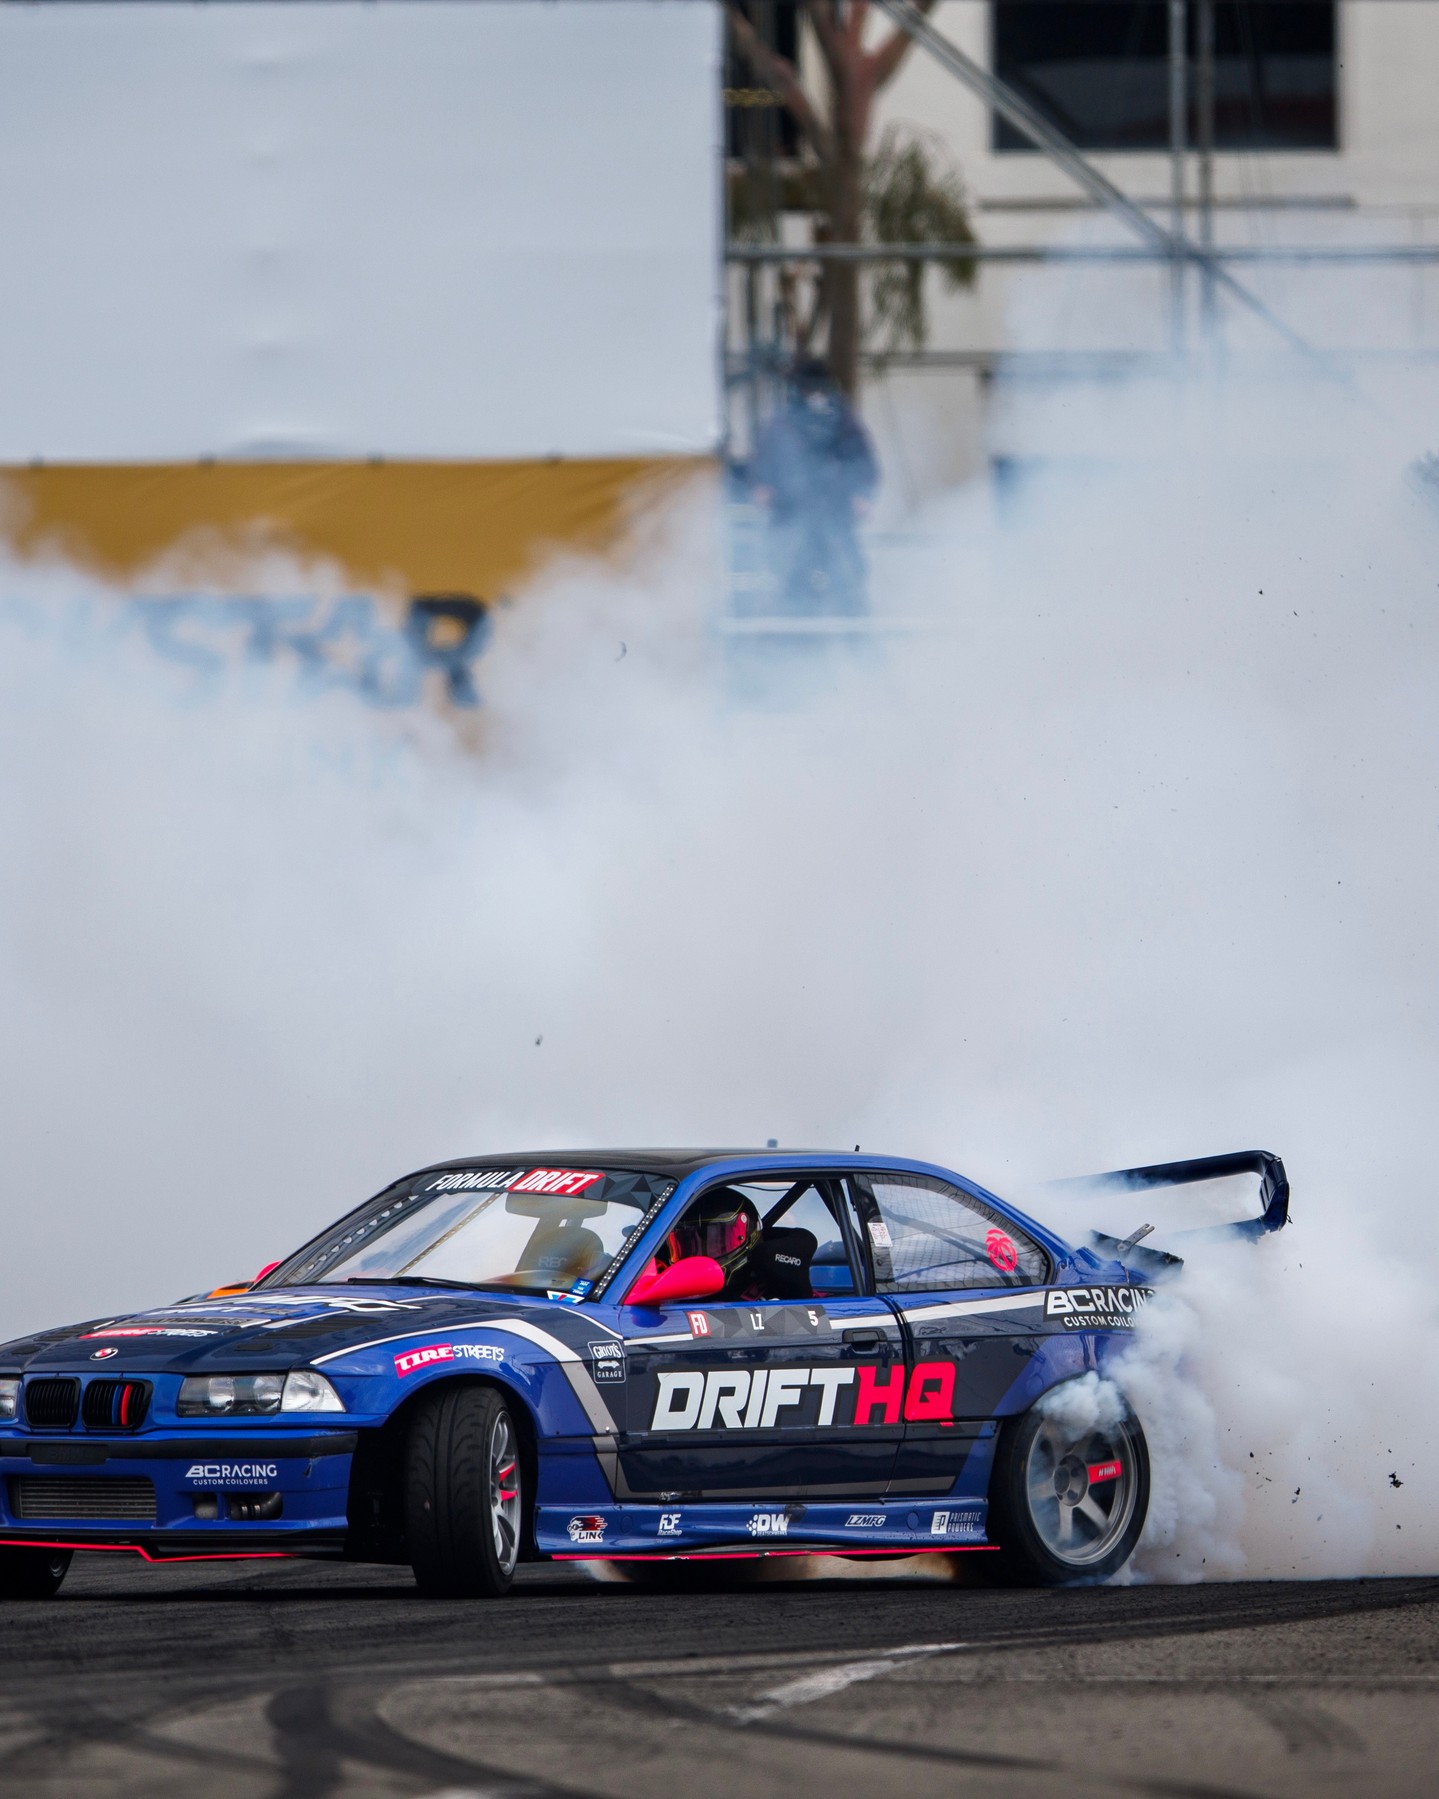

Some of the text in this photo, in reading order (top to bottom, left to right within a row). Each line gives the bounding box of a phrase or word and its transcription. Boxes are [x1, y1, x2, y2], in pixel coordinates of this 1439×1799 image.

[425, 1171, 599, 1193] FORMULA DRIFT
[538, 1256, 567, 1268] REC
[775, 1253, 802, 1266] RECARO
[690, 1313, 708, 1334] FD
[807, 1310, 819, 1326] 5
[1063, 1316, 1107, 1327] CUSTOM
[757, 1514, 790, 1531] DW
[950, 1512, 981, 1522] PRISMATIC
[579, 1531, 602, 1540] LINK
